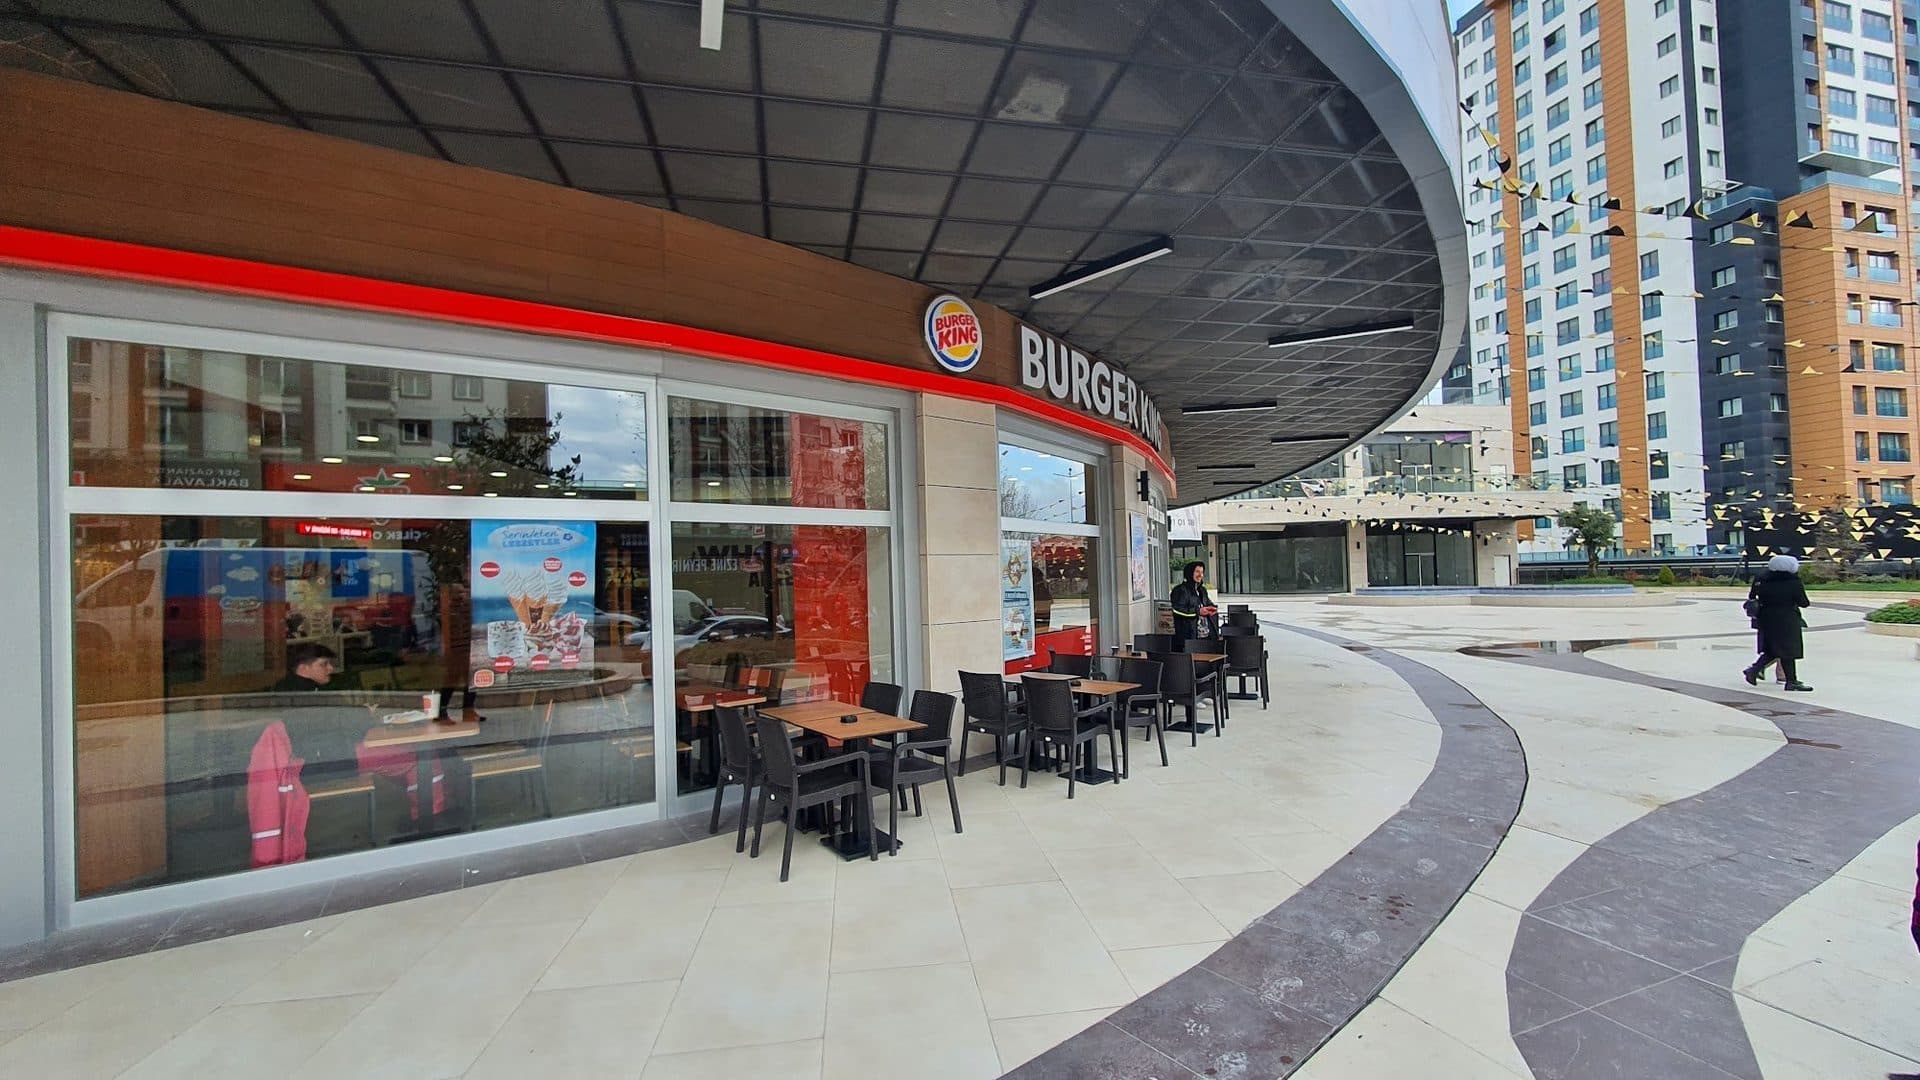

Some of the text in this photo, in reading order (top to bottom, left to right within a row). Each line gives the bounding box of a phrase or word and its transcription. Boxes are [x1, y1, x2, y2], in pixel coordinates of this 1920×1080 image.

[935, 313, 976, 330] BURGER
[937, 324, 978, 350] KING
[1021, 325, 1162, 451] BURGER KING
